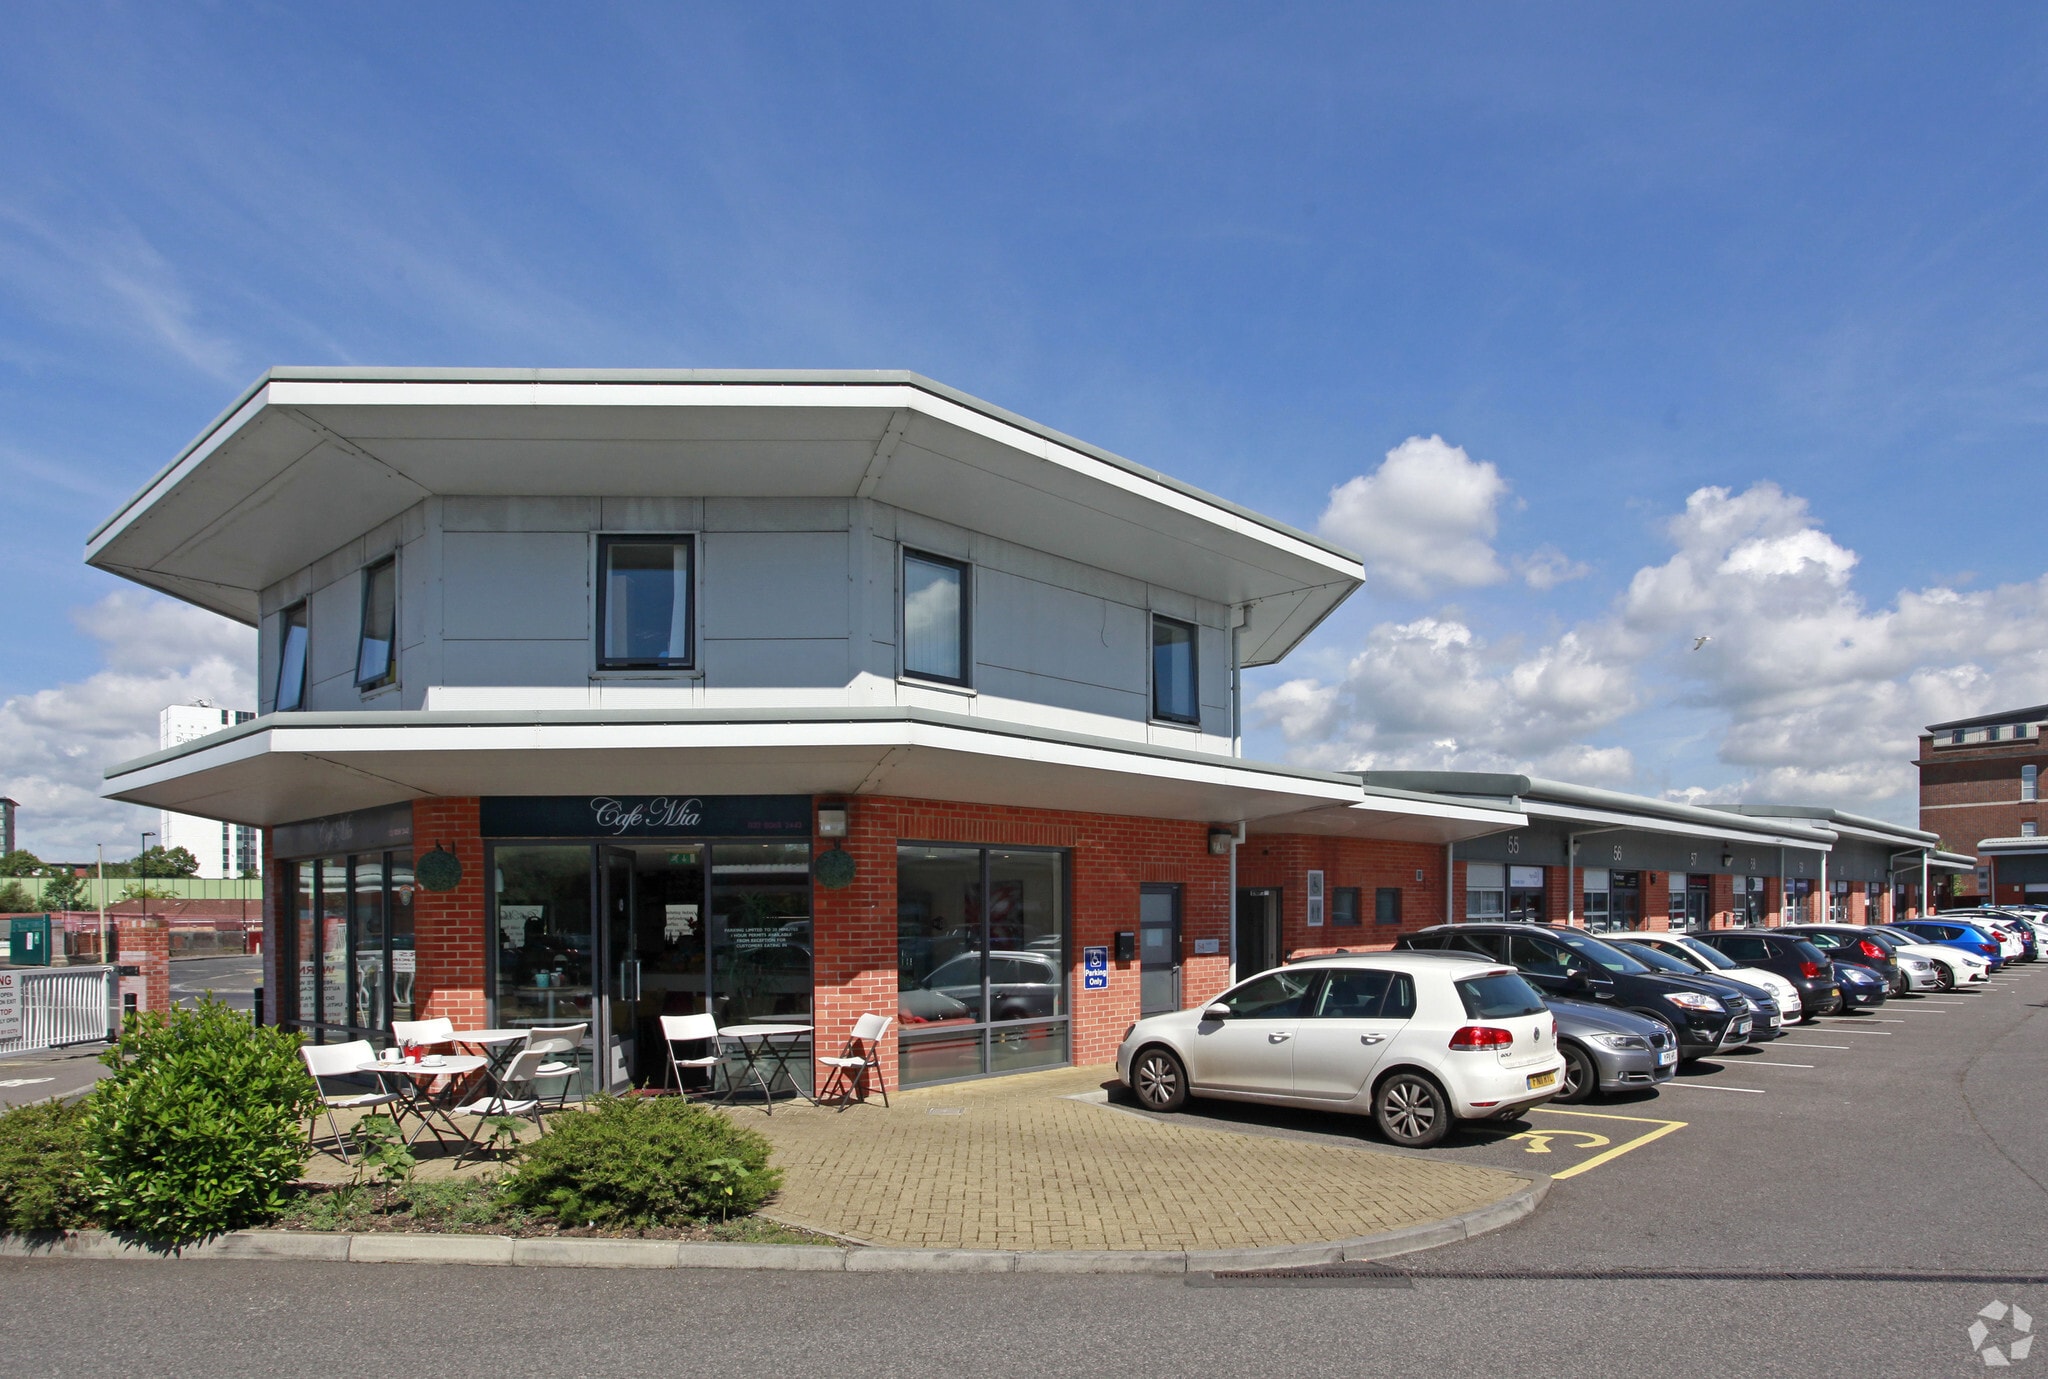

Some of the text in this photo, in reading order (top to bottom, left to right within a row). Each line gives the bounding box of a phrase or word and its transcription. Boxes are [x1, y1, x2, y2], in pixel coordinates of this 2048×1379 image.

[646, 797, 703, 826] Mia
[1508, 836, 1519, 854] 55
[1613, 845, 1622, 861] 56
[1690, 852, 1697, 867] 57
[1085, 969, 1106, 977] Parking
[1089, 977, 1103, 986] Only
